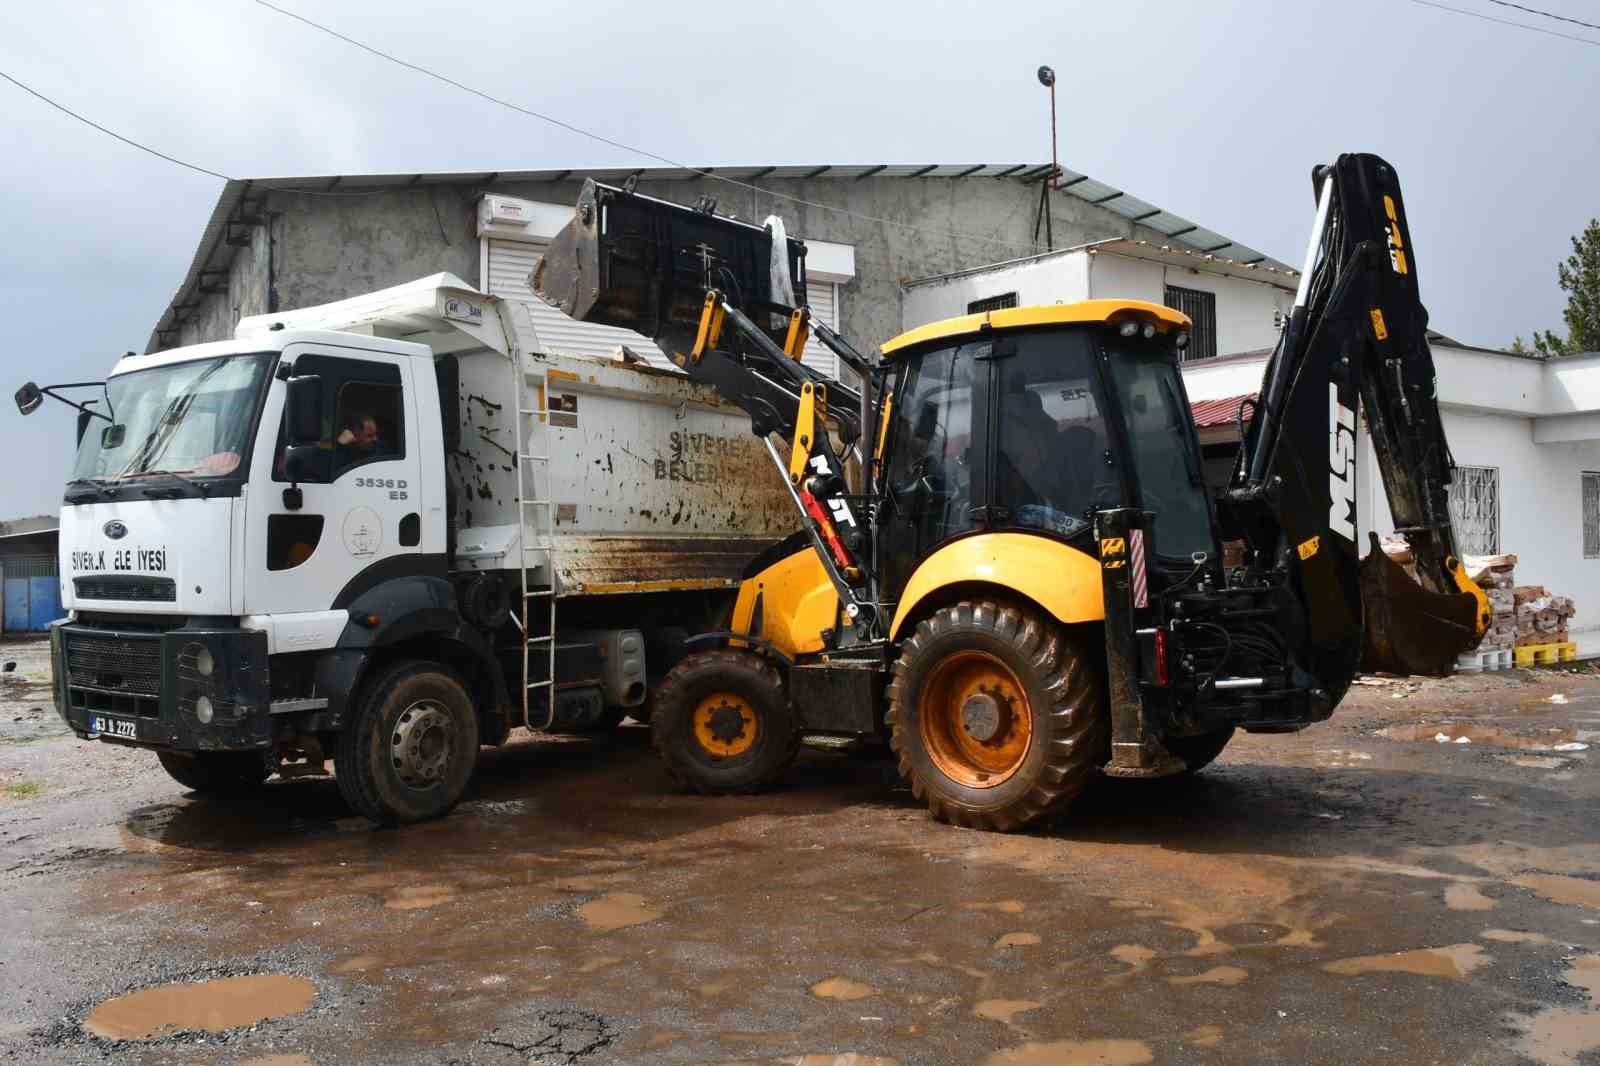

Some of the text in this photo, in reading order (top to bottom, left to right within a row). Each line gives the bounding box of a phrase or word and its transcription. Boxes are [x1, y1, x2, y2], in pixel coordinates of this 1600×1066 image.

[1329, 381, 1355, 542] MST
[397, 479, 408, 489] D
[389, 490, 408, 500] E5
